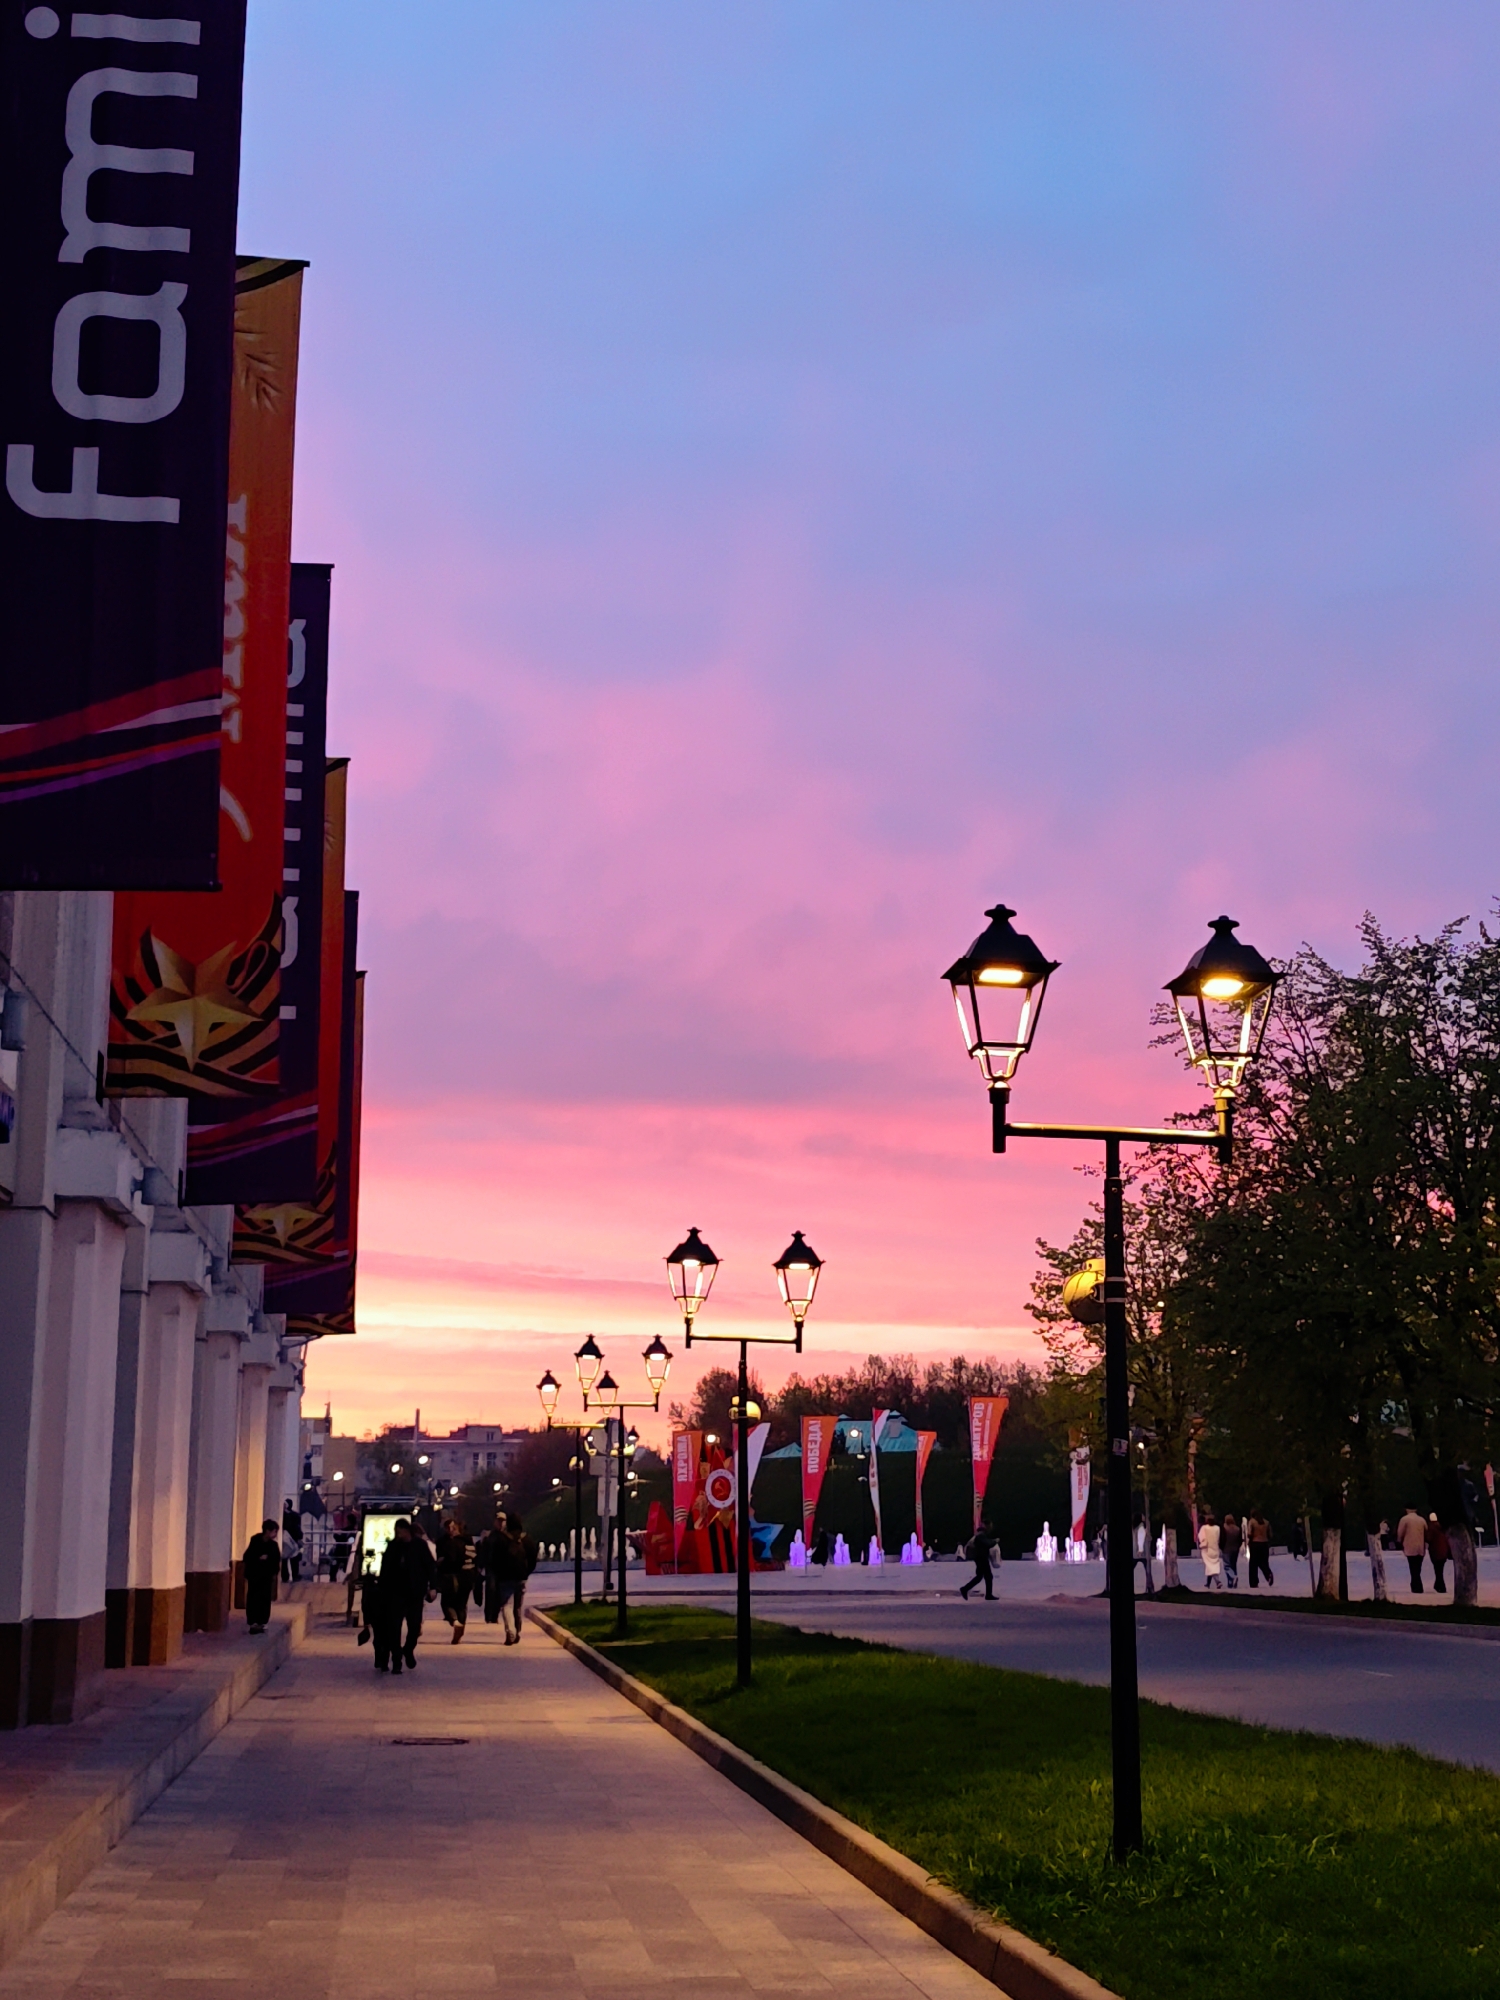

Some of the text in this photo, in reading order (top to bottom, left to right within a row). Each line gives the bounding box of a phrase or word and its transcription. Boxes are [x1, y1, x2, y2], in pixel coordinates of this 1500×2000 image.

[676, 1435, 688, 1482] ЯХРОМА
[807, 1419, 823, 1474] ПОБЕДА!
[972, 1402, 985, 1462] ДМИТРОВ
